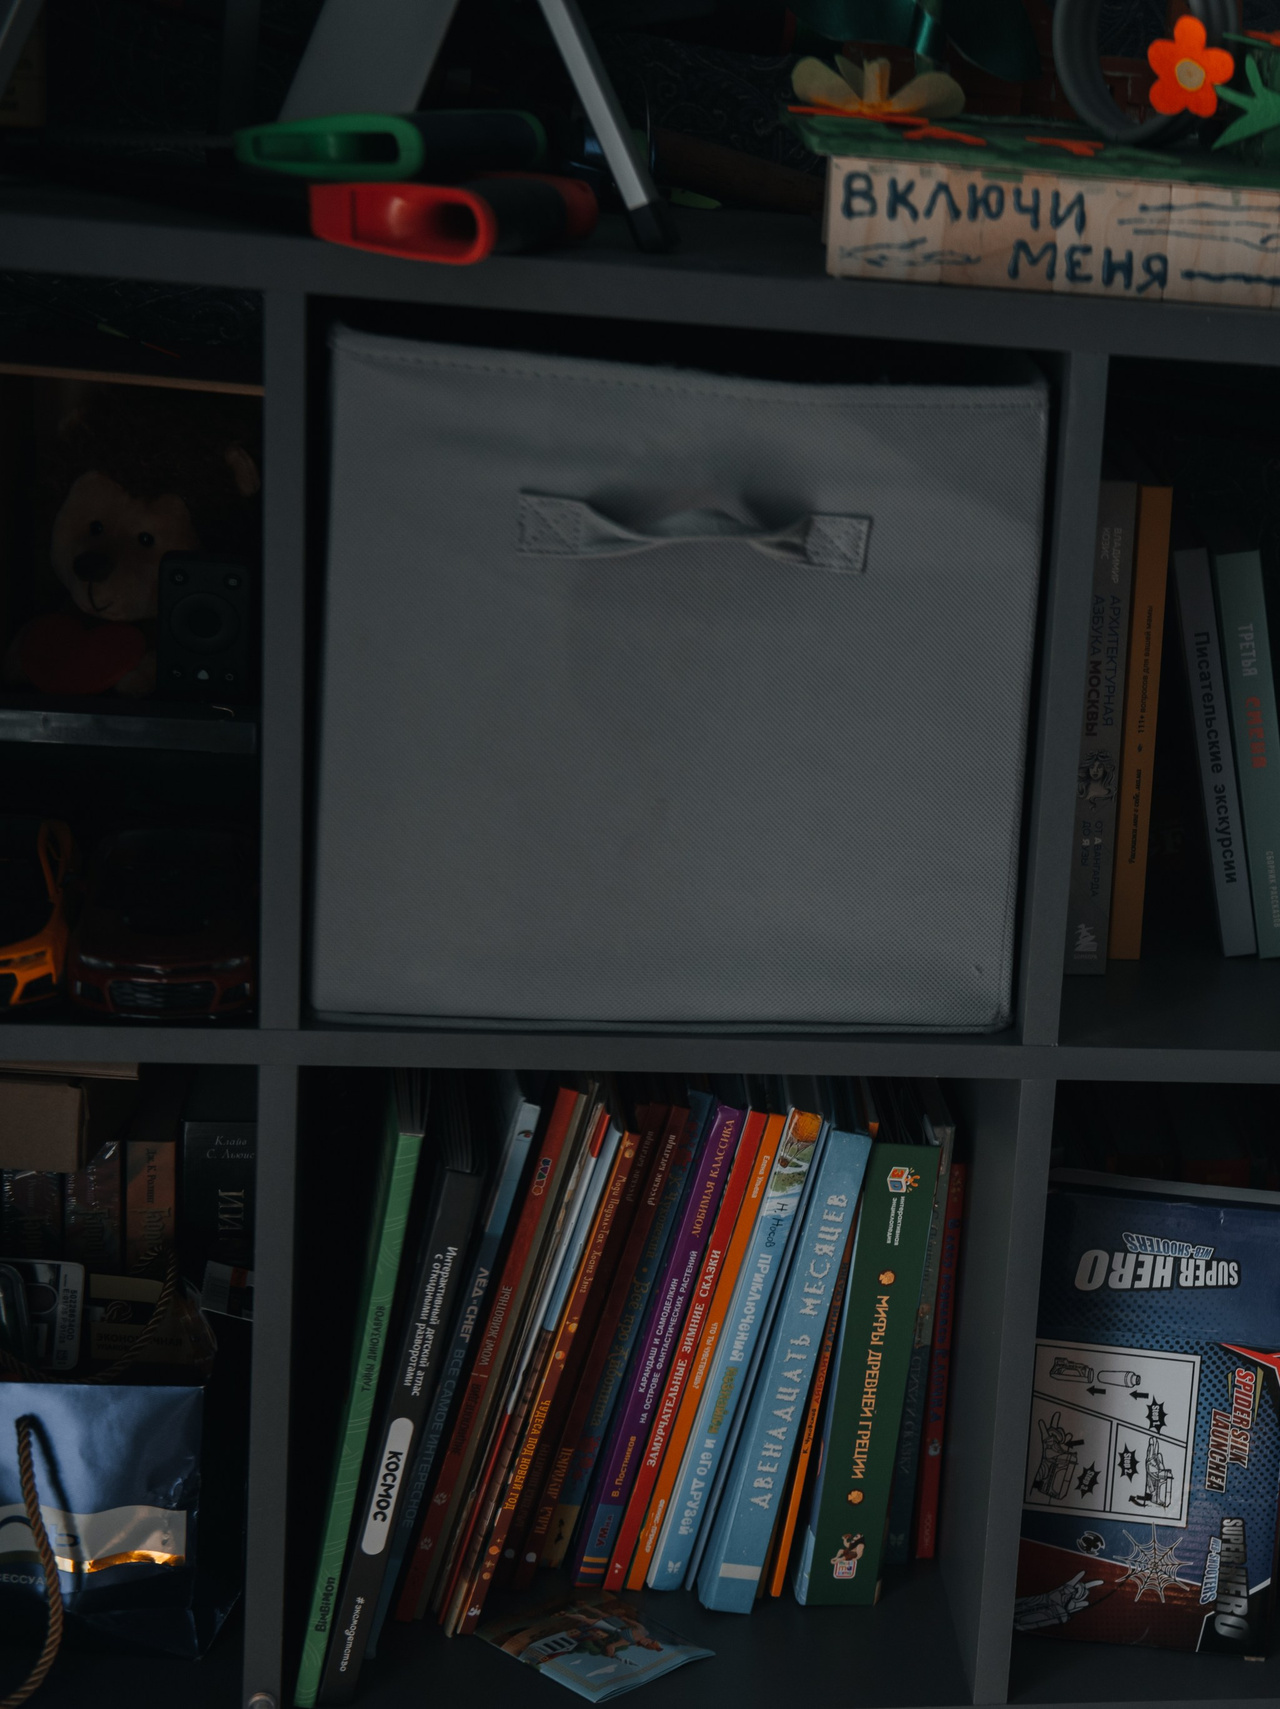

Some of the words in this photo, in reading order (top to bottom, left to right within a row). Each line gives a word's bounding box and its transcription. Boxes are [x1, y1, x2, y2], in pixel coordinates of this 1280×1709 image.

[841, 172, 1087, 235] ВКЛЮЧИ
[1007, 240, 1169, 293] МЕНЯ
[1109, 526, 1122, 584] ВЛАДИМИР
[1088, 594, 1105, 656] АЗБУКА
[1101, 595, 1121, 726] АРХИТЕКТУРНАЯ
[1235, 623, 1260, 677] ТРЕТЬЯ
[1084, 659, 1102, 737] МОСКВЫ
[1193, 630, 1226, 774] Писательские
[1080, 819, 1091, 836] ДО
[1094, 819, 1103, 833] ОТ
[1209, 783, 1237, 884] экскурсии
[1079, 837, 1090, 866] ЯУЗЫ
[1089, 836, 1103, 897] АВАНГАРДА
[1264, 849, 1277, 884] СБОРНИК
[214, 1135, 247, 1147] Клайв
[757, 1153, 771, 1176] Елена
[608, 1173, 627, 1197] Моди
[690, 1179, 716, 1239] ЛЮБИМАЯ
[708, 1117, 735, 1179] КЛАССИКА
[773, 1200, 789, 1216] Н.
[893, 1195, 905, 1246] интерактивная
[433, 1252, 443, 1260] с
[763, 1215, 784, 1250] Носов
[1119, 1231, 1214, 1262] WEB-SHOOTERS
[426, 1244, 458, 1326] Интерактивный
[584, 1248, 602, 1275] Хоанг
[677, 1248, 698, 1294] РАСТЕНИЙ
[833, 1261, 849, 1303] СКАЗКИ
[1072, 1246, 1175, 1292] HERO
[1177, 1256, 1239, 1287] SUPER
[417, 1261, 441, 1320] откидными
[624, 1275, 651, 1310] Всё
[654, 1276, 680, 1336] САМОДЕЛКИН
[365, 1303, 387, 1362] ДИНОЗАВРОВ
[476, 1337, 496, 1368] WOW!
[486, 1283, 513, 1339] ЖИВОТНЫЕ
[613, 1310, 635, 1342] про
[651, 1336, 661, 1345] И
[654, 1293, 685, 1370] ФАНТАСТИЧЕСКИХ
[704, 1334, 715, 1346] ТЫ
[708, 1320, 719, 1335] ЧТО
[825, 1303, 840, 1343] ДРУГИЕ
[869, 1293, 890, 1346] МИФЫ
[400, 1322, 427, 1387] разворотами
[415, 1326, 438, 1369] детский
[637, 1344, 659, 1393] КАРАНДАШ
[645, 1356, 688, 1468] ЗАМУРЧАТЕЛЬНЫЕ
[679, 1300, 706, 1354] ЗИМНИЕ
[697, 1247, 722, 1298] СКАЗКИ
[691, 1344, 712, 1390] ЧУВСТВУЕШЬ?
[745, 1330, 815, 1510] ДВЕНАДЦАТЬ
[795, 1189, 852, 1319] МЕСЯЦЕВ
[823, 1343, 832, 1352] И
[359, 1362, 376, 1393] ТАЙНЫ
[409, 1369, 425, 1397] атлас
[584, 1341, 632, 1430] Айболита
[642, 1370, 661, 1410] ОСТРОВЕ
[811, 1353, 830, 1404] АЙБОЛИТ
[857, 1348, 885, 1419] ДРЕВНЕЙ
[905, 1354, 923, 1403] СТИХИ
[1229, 1368, 1256, 1429] SPIDER
[430, 1377, 457, 1432] САМОЕ
[448, 1381, 484, 1456] ЭНЦИКЛОПЕДИЯ
[527, 1396, 553, 1437] ЧУДЕСА
[638, 1410, 649, 1424] НА
[1150, 1404, 1160, 1421] Step
[520, 1434, 539, 1458] ПОД
[613, 1433, 638, 1487] Постников
[849, 1419, 872, 1480] ГРЕЦИИ
[896, 1419, 916, 1475] СКАЗКИ
[1120, 1451, 1133, 1469] Step
[1226, 1428, 1251, 1467] SILK
[372, 1448, 404, 1523] КОСМОС
[400, 1432, 441, 1529] ИНТЕРЕСНОЕ
[509, 1455, 533, 1492] НОВЫЙ
[610, 1485, 621, 1499] В.
[1081, 1468, 1095, 1486] Step
[502, 1489, 520, 1513] ГОД
[1219, 1517, 1245, 1564] SUPER
[1198, 1535, 1223, 1606] WEB-SHOOTERS
[1211, 1565, 1249, 1642] HERO
[335, 1594, 365, 1673] #эксмодетство
